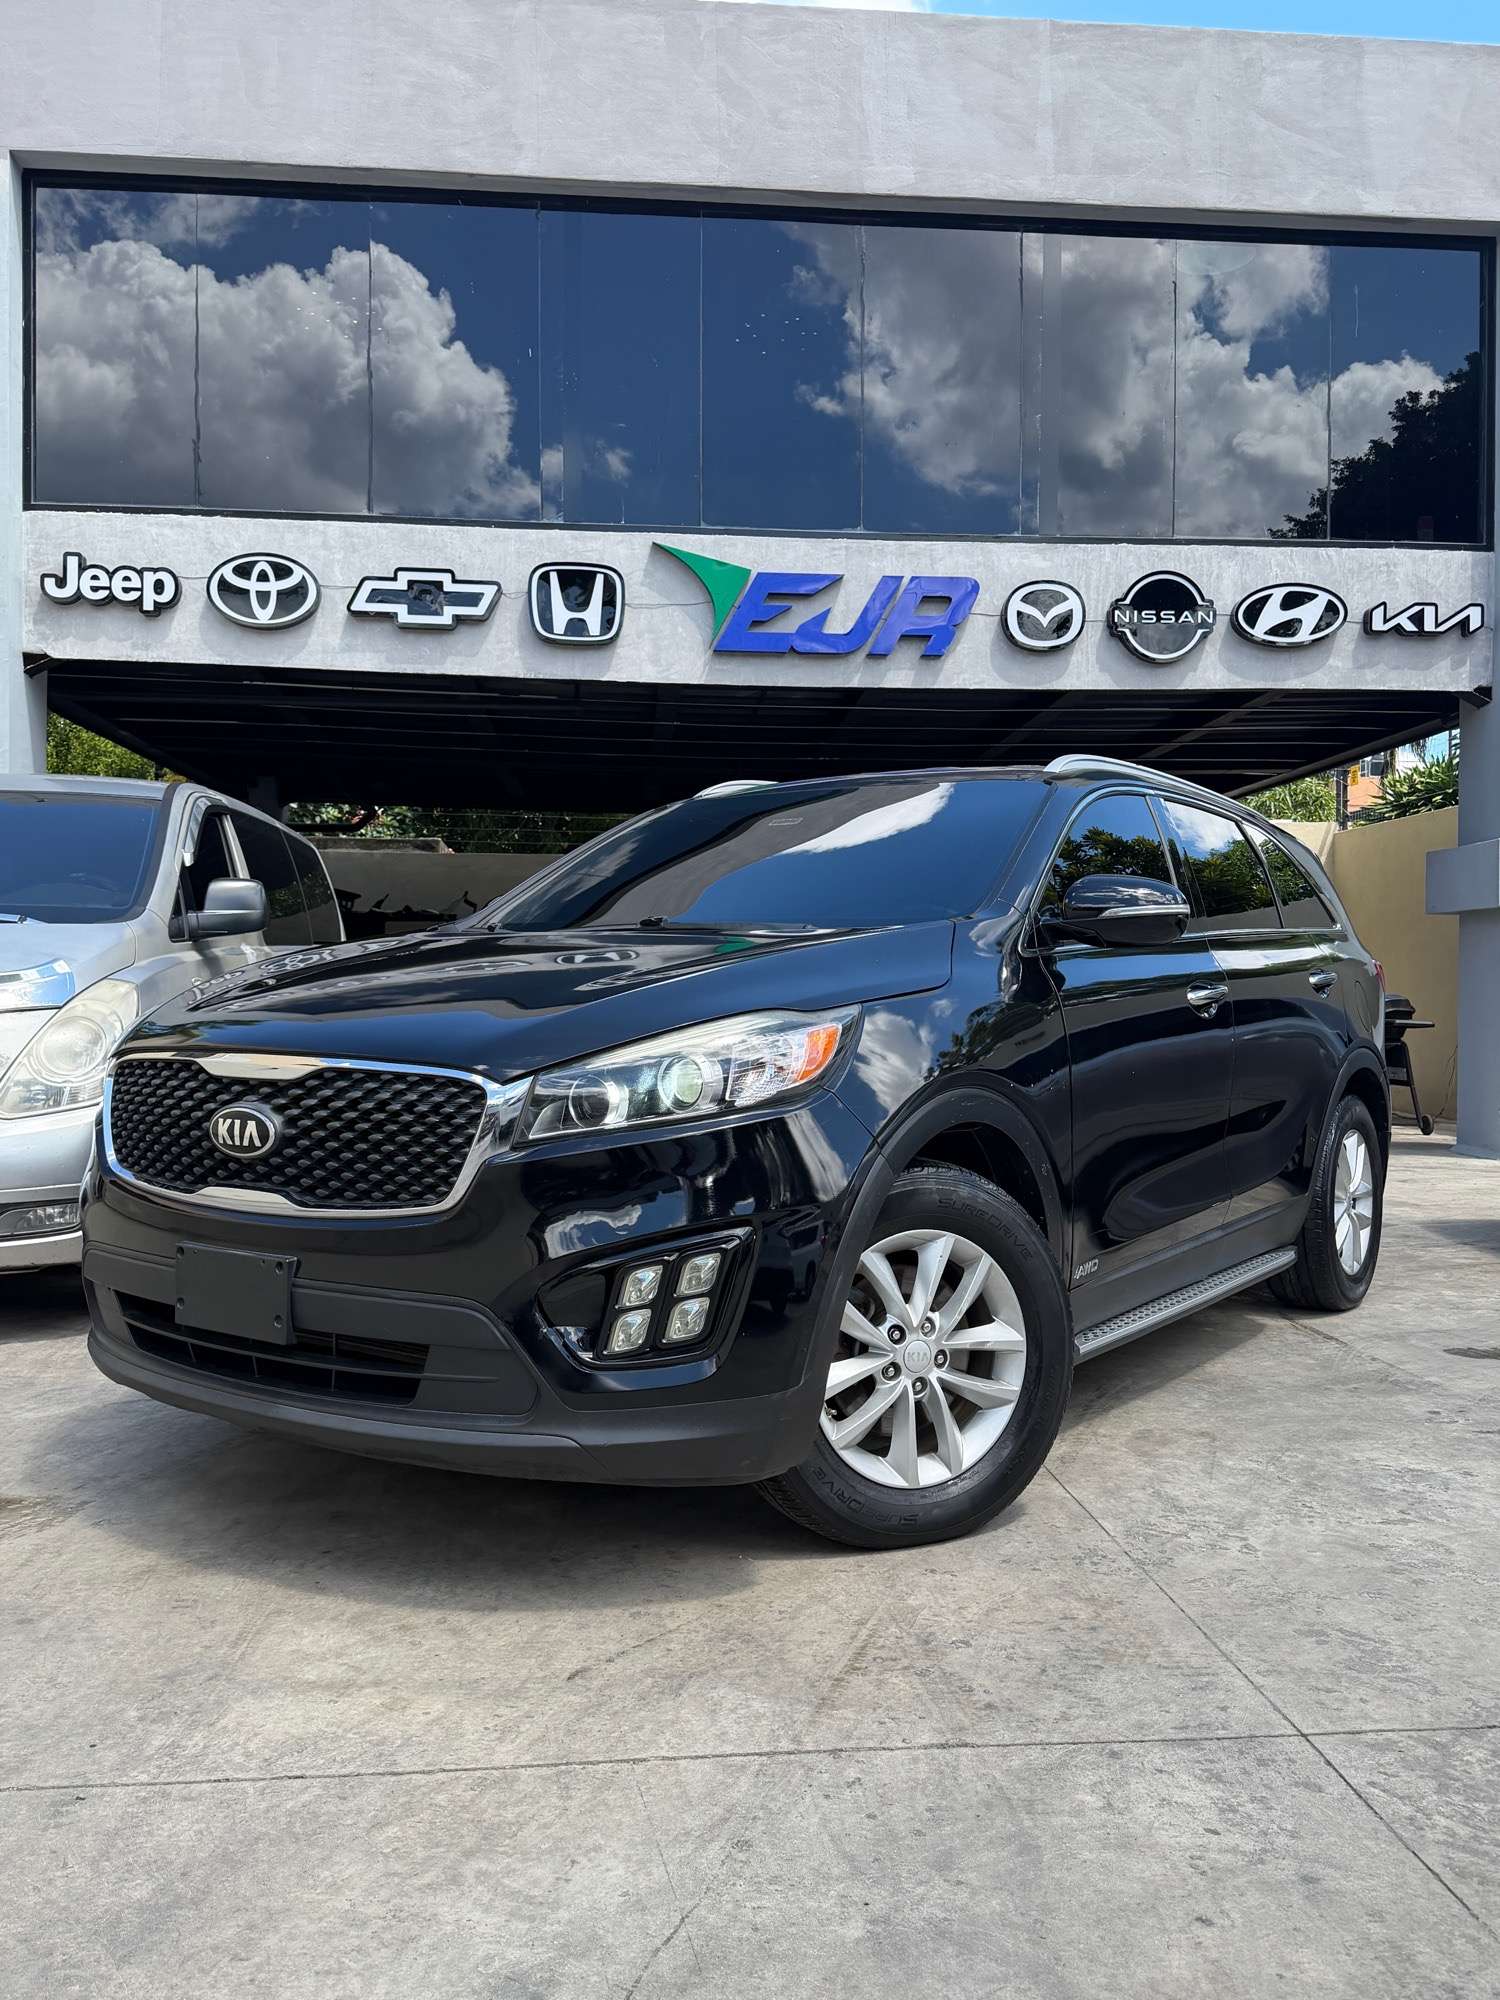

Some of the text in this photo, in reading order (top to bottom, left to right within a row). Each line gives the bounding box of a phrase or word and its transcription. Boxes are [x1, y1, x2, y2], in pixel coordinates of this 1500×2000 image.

[42, 554, 178, 612] Jeep
[1113, 610, 1213, 625] NISSAN
[1369, 601, 1485, 634] KIA
[217, 1117, 262, 1148] KIA
[907, 1351, 930, 1363] KIA
